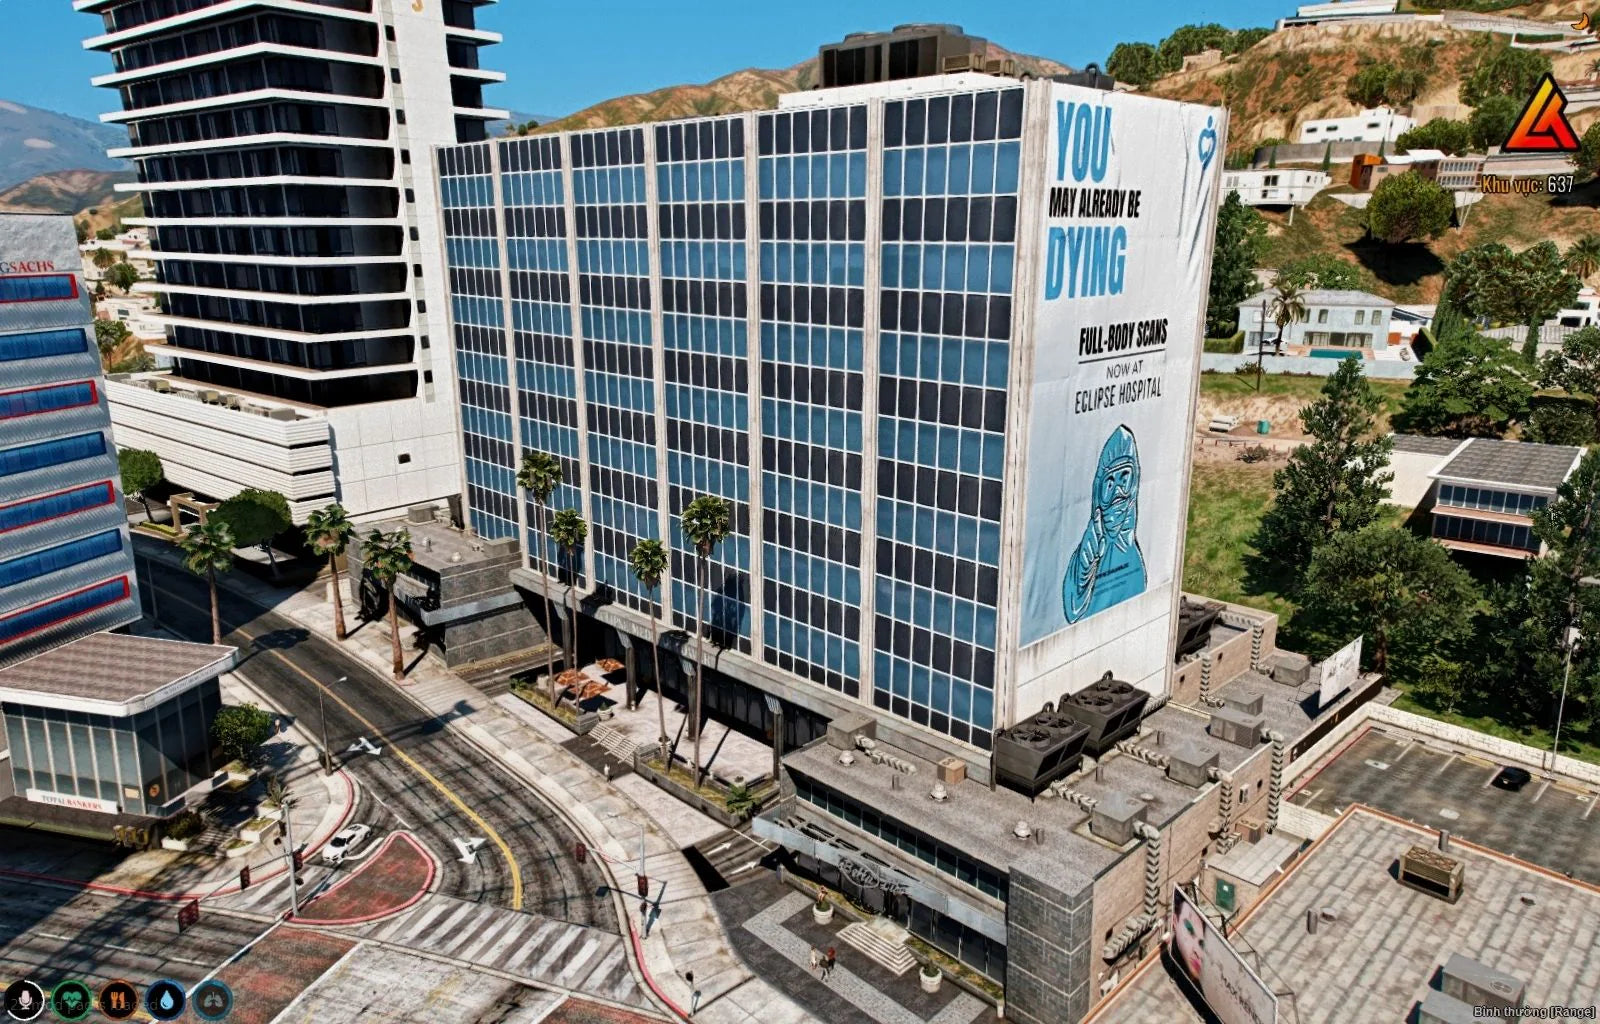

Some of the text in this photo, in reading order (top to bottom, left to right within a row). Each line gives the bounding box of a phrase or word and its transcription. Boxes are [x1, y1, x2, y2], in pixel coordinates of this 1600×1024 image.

[1056, 99, 1112, 183] YOU
[1049, 187, 1141, 218] MAY ALREADY BE
[1044, 225, 1127, 301] DYING
[1078, 318, 1169, 356] FULL-BODY SCANS
[1106, 359, 1144, 379] NOW AT
[1074, 376, 1162, 414] ECLIPSE HOSPITAL
